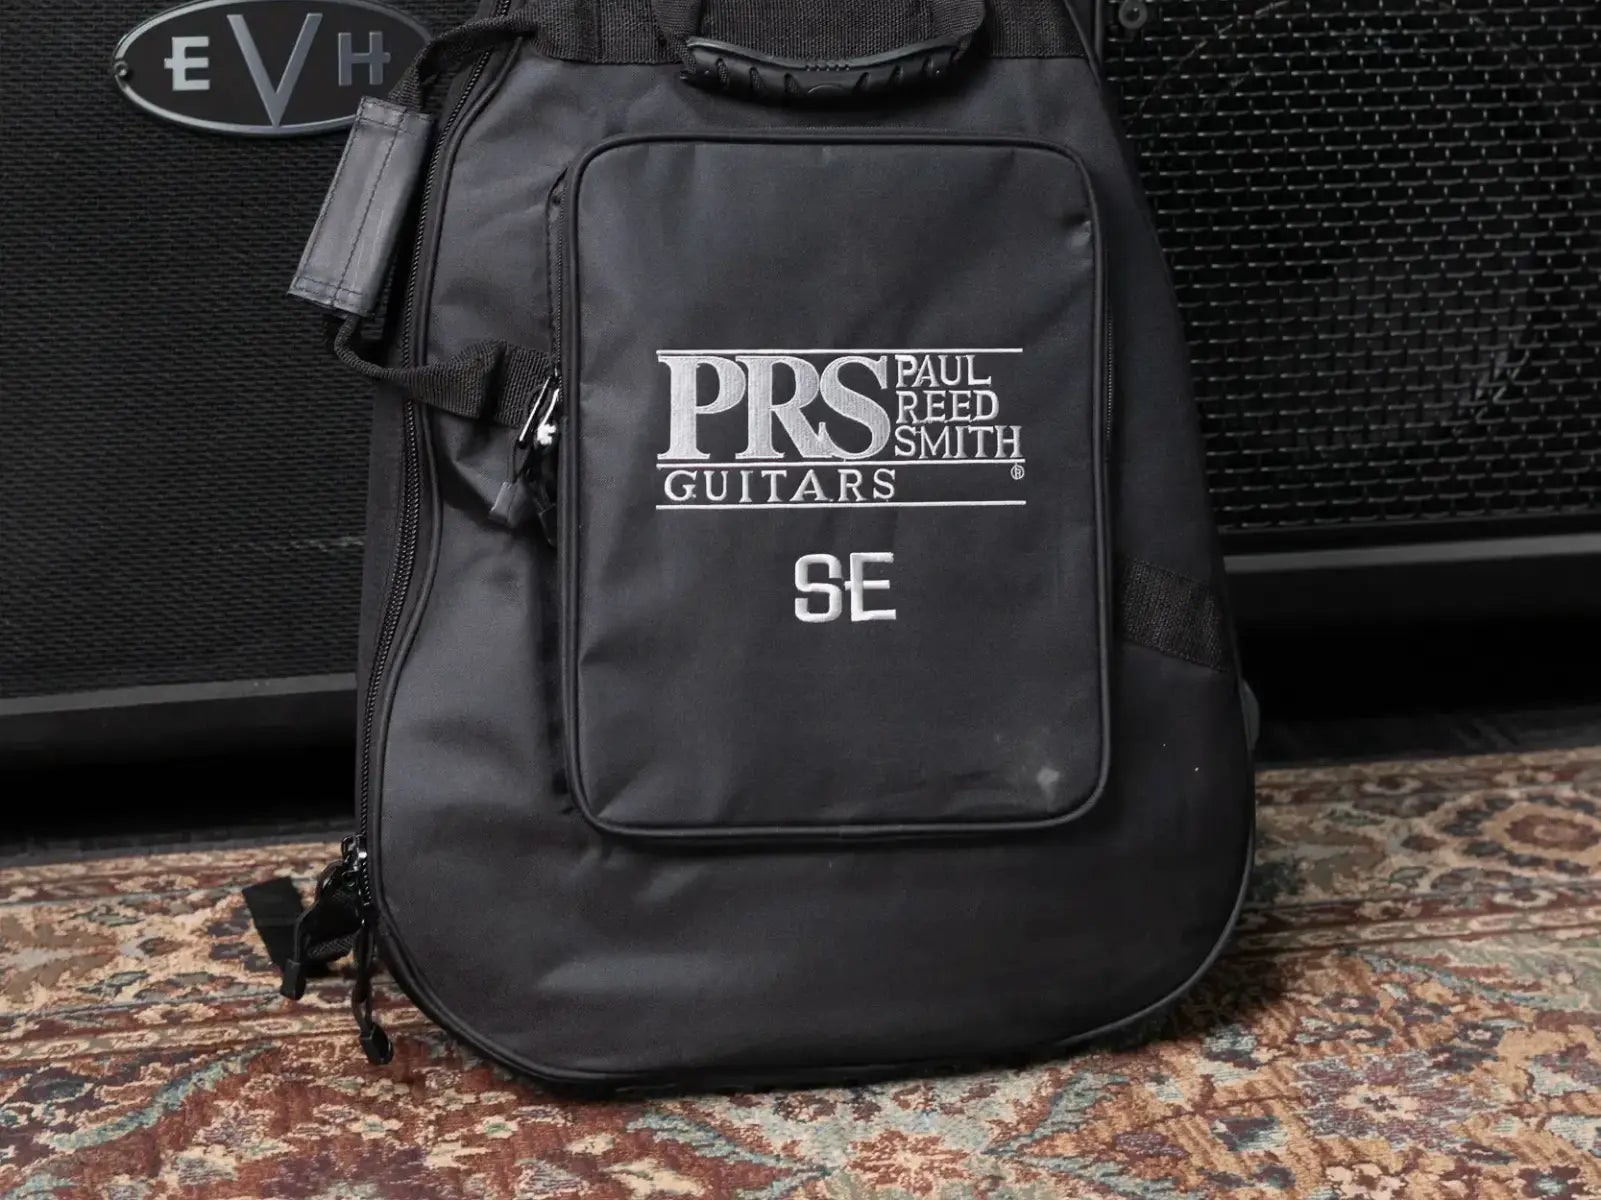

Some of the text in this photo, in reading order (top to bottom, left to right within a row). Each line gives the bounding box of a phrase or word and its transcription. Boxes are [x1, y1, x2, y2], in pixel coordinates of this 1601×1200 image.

[164, 13, 391, 128] EVH
[895, 354, 992, 388] PAUL
[657, 355, 891, 460] PRS
[896, 390, 1000, 424] REED
[894, 424, 1022, 459] SMITH
[664, 468, 896, 502] GUITARS
[795, 552, 896, 623] SE
